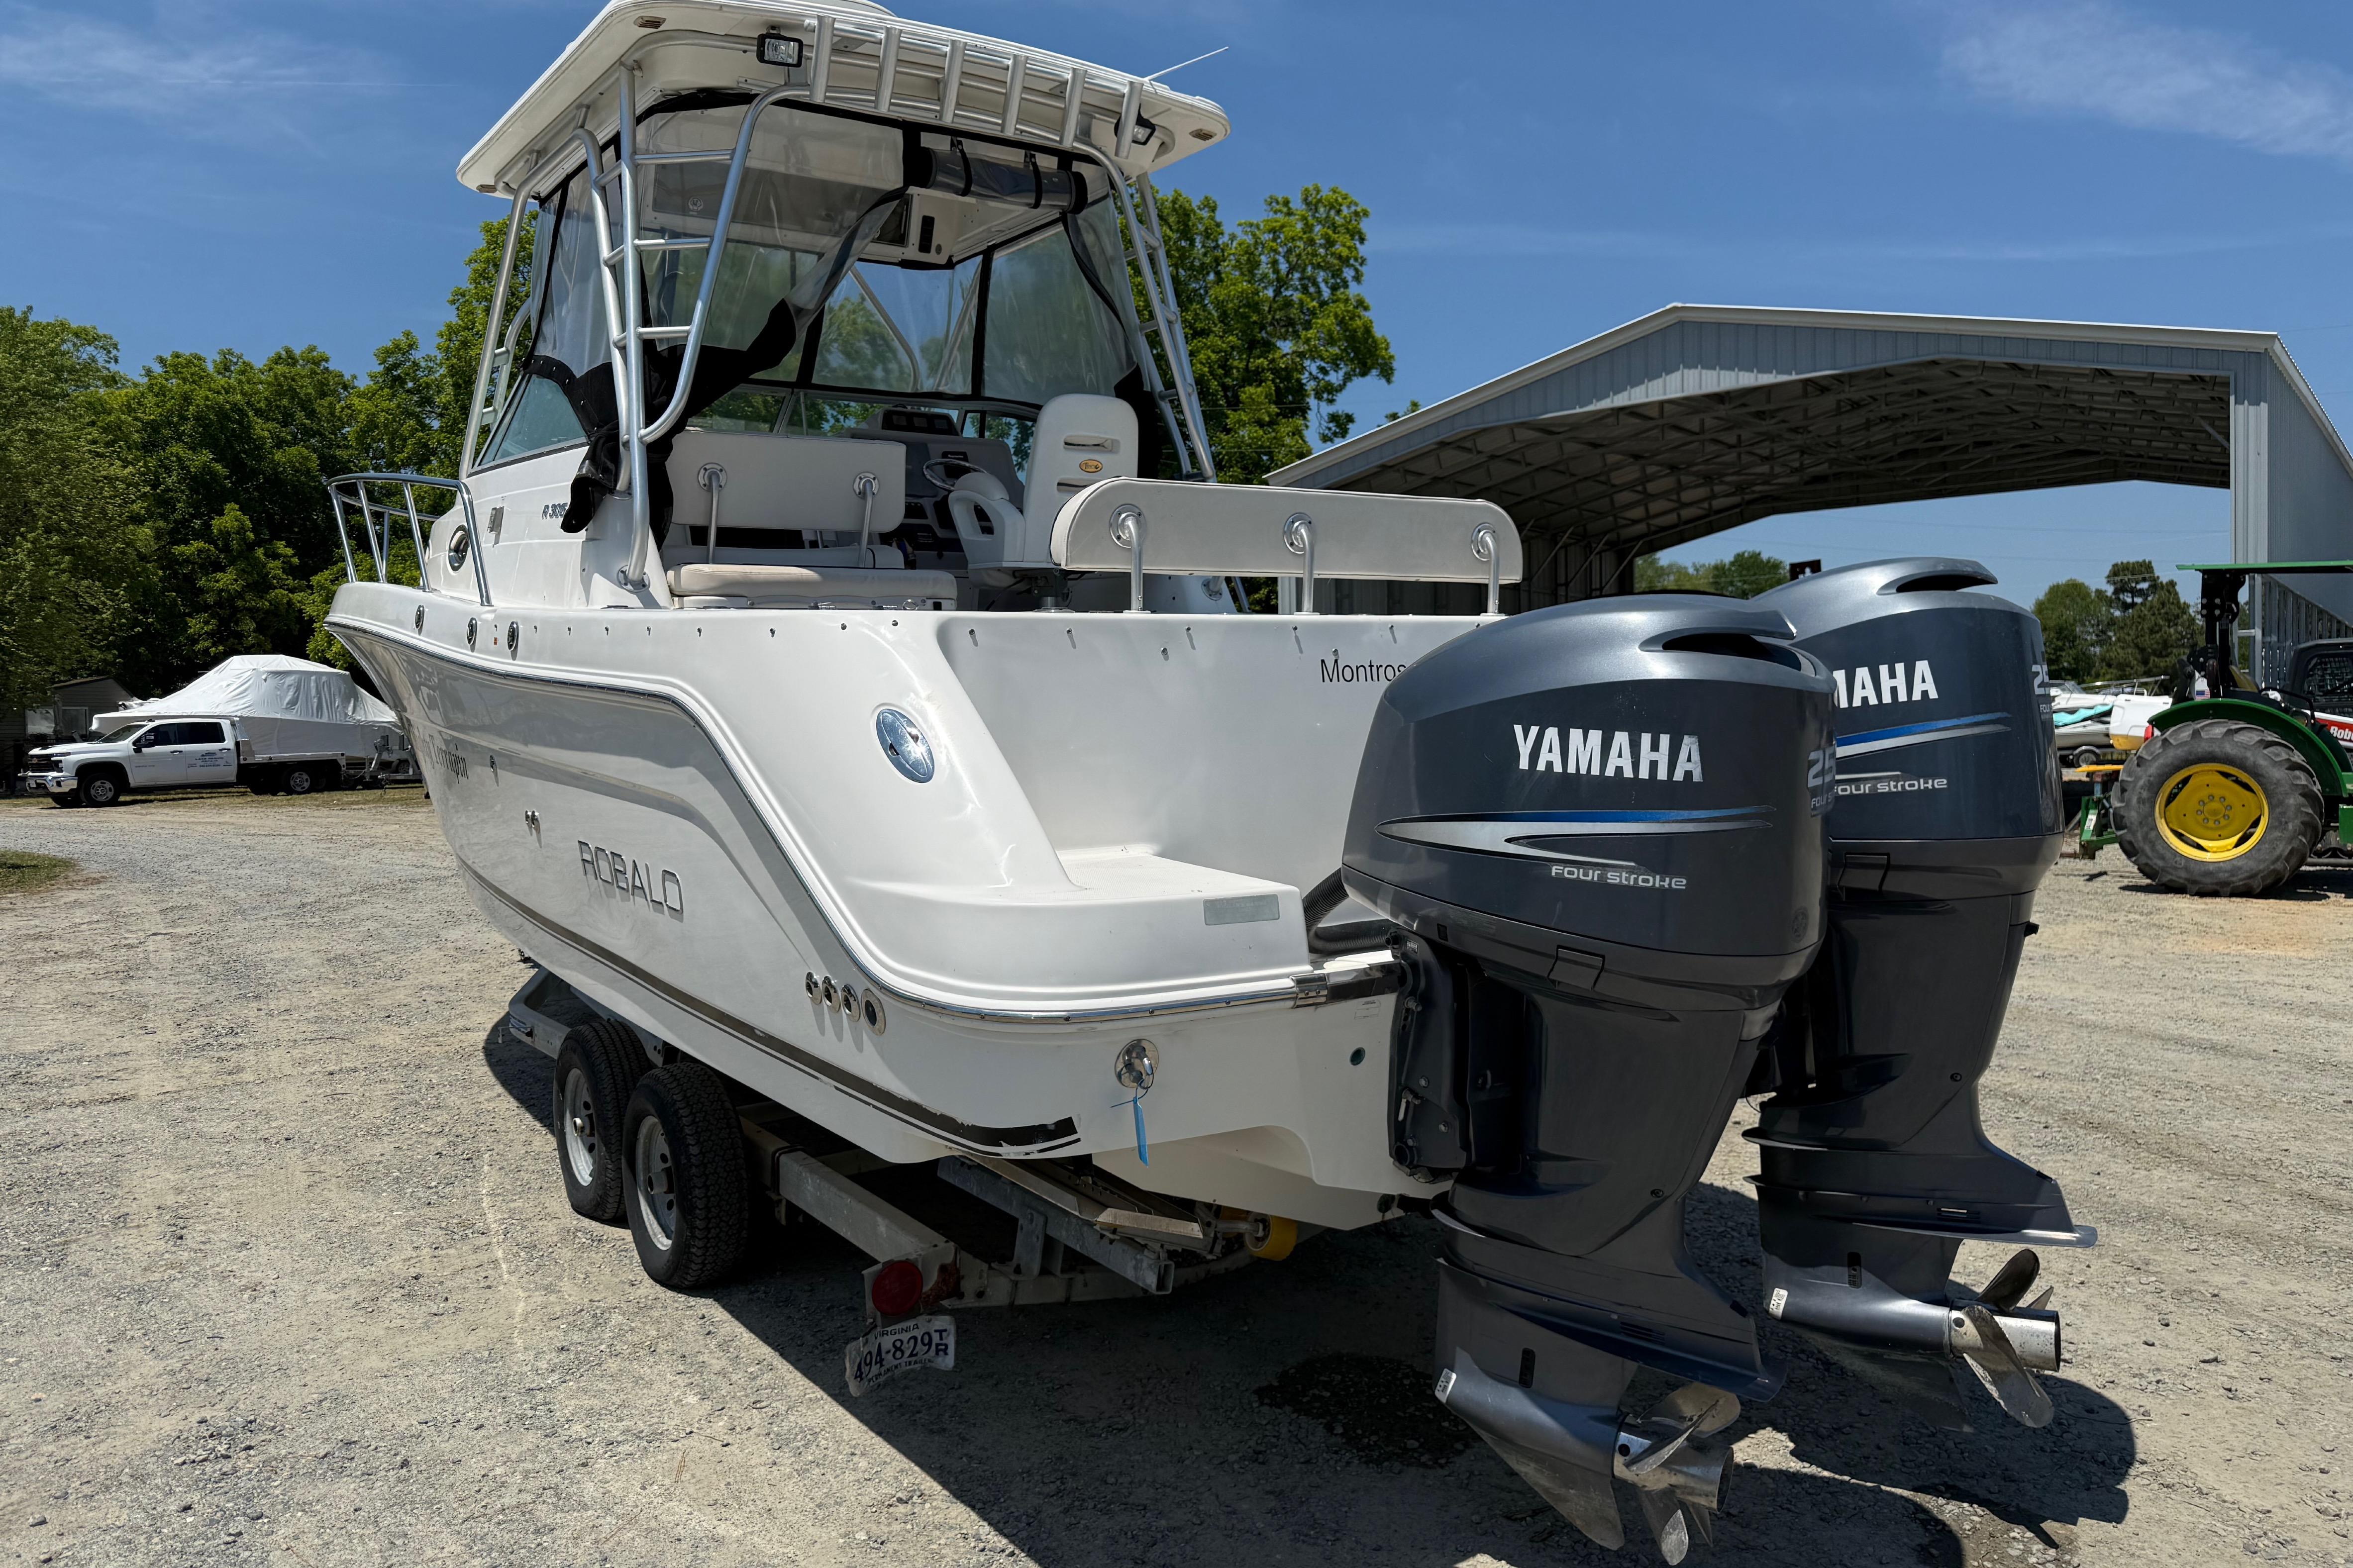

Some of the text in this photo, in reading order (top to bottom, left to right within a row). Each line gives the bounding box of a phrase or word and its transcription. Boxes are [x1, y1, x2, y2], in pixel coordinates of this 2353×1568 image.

[2032, 665, 2050, 694] 25
[429, 733, 469, 784] Terrapin
[1514, 724, 1703, 782] YAMAHA
[1808, 747, 1836, 787] 25
[578, 840, 684, 915] ROBALO
[854, 1331, 933, 1383] 494-829
[874, 1323, 920, 1340] VIRGINIA
